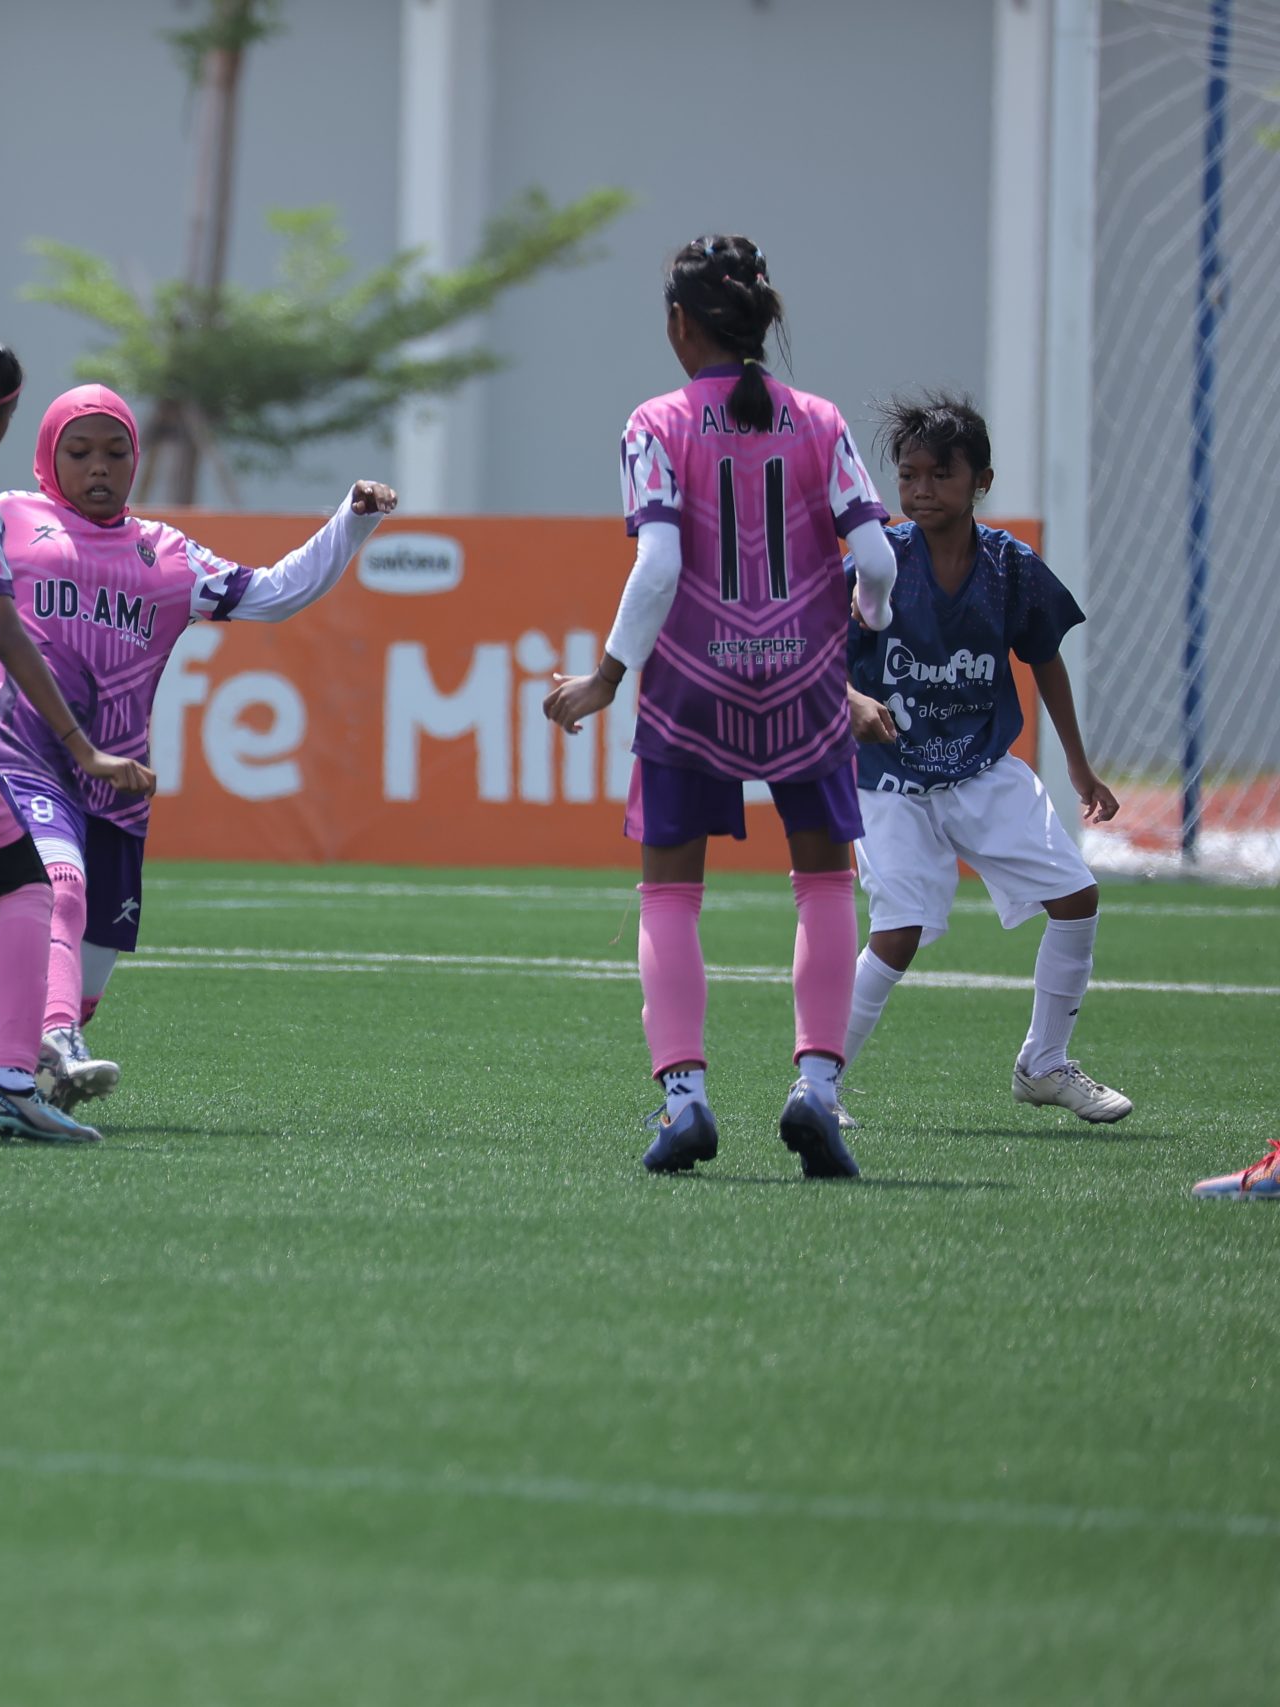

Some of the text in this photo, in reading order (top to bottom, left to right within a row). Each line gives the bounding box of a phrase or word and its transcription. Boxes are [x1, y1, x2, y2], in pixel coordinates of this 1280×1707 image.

[717, 456, 790, 603] 11
[34, 579, 157, 640] UD.AMJ
[708, 637, 807, 657] RICKSPORT
[30, 795, 54, 823] 9
